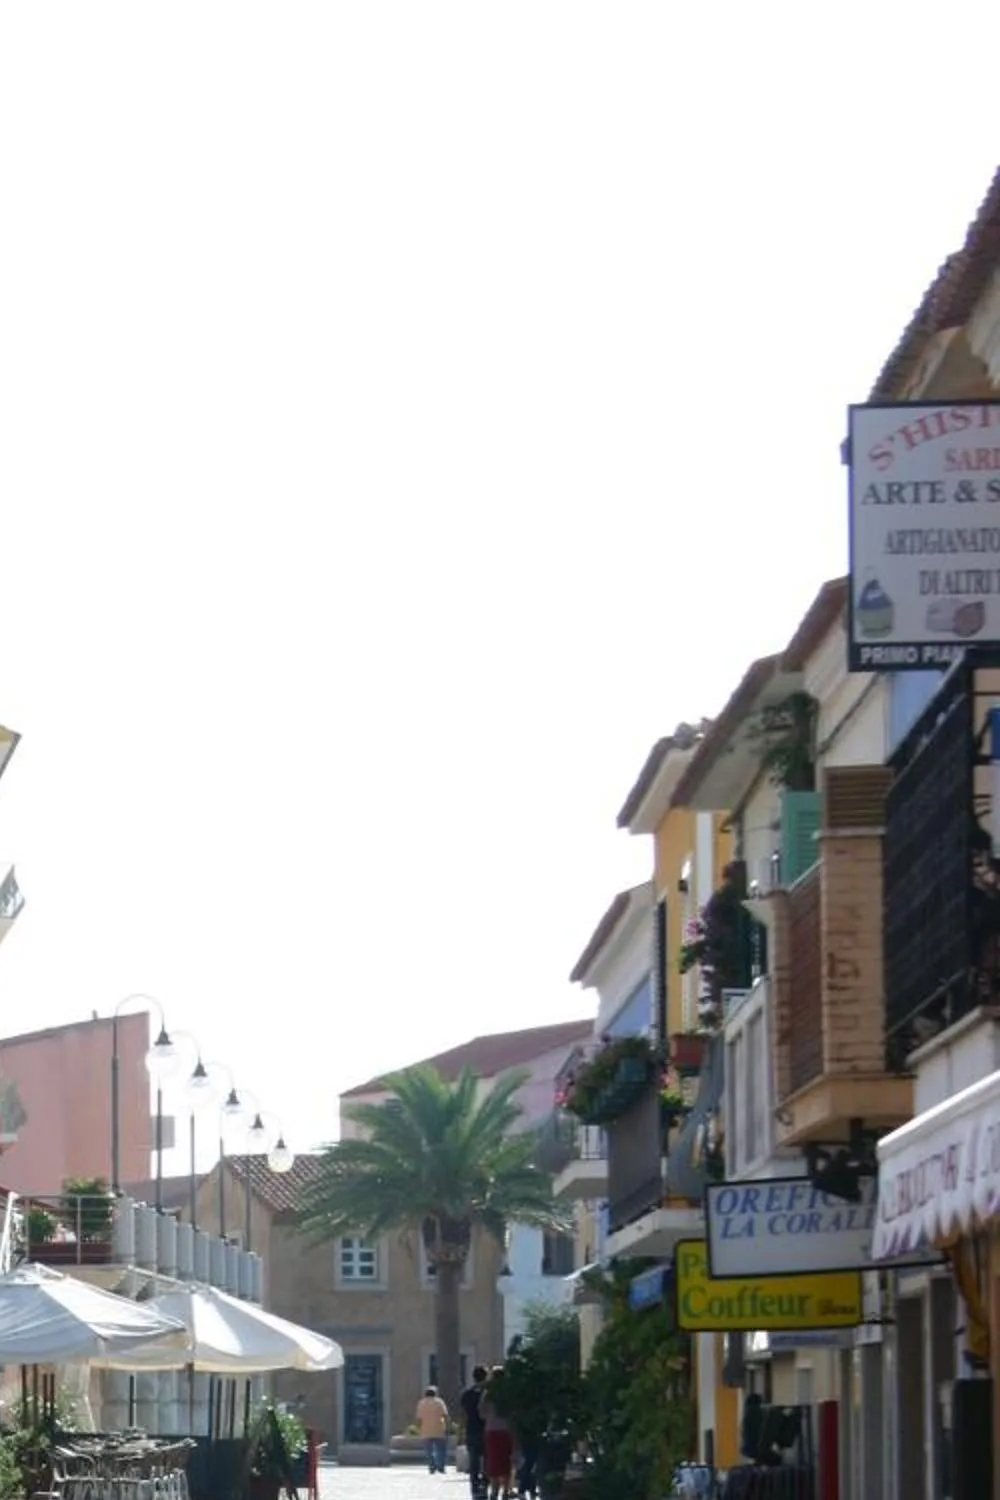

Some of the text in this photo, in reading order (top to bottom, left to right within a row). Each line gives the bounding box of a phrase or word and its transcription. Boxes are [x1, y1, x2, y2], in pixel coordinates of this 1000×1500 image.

[867, 405, 1000, 472] S'HIST
[861, 481, 946, 505] ARTE
[953, 480, 977, 503] &
[919, 569, 940, 596] DI
[860, 645, 918, 665] PRIMO
[720, 1217, 755, 1239] LA
[682, 1285, 811, 1319] Coiffeur
